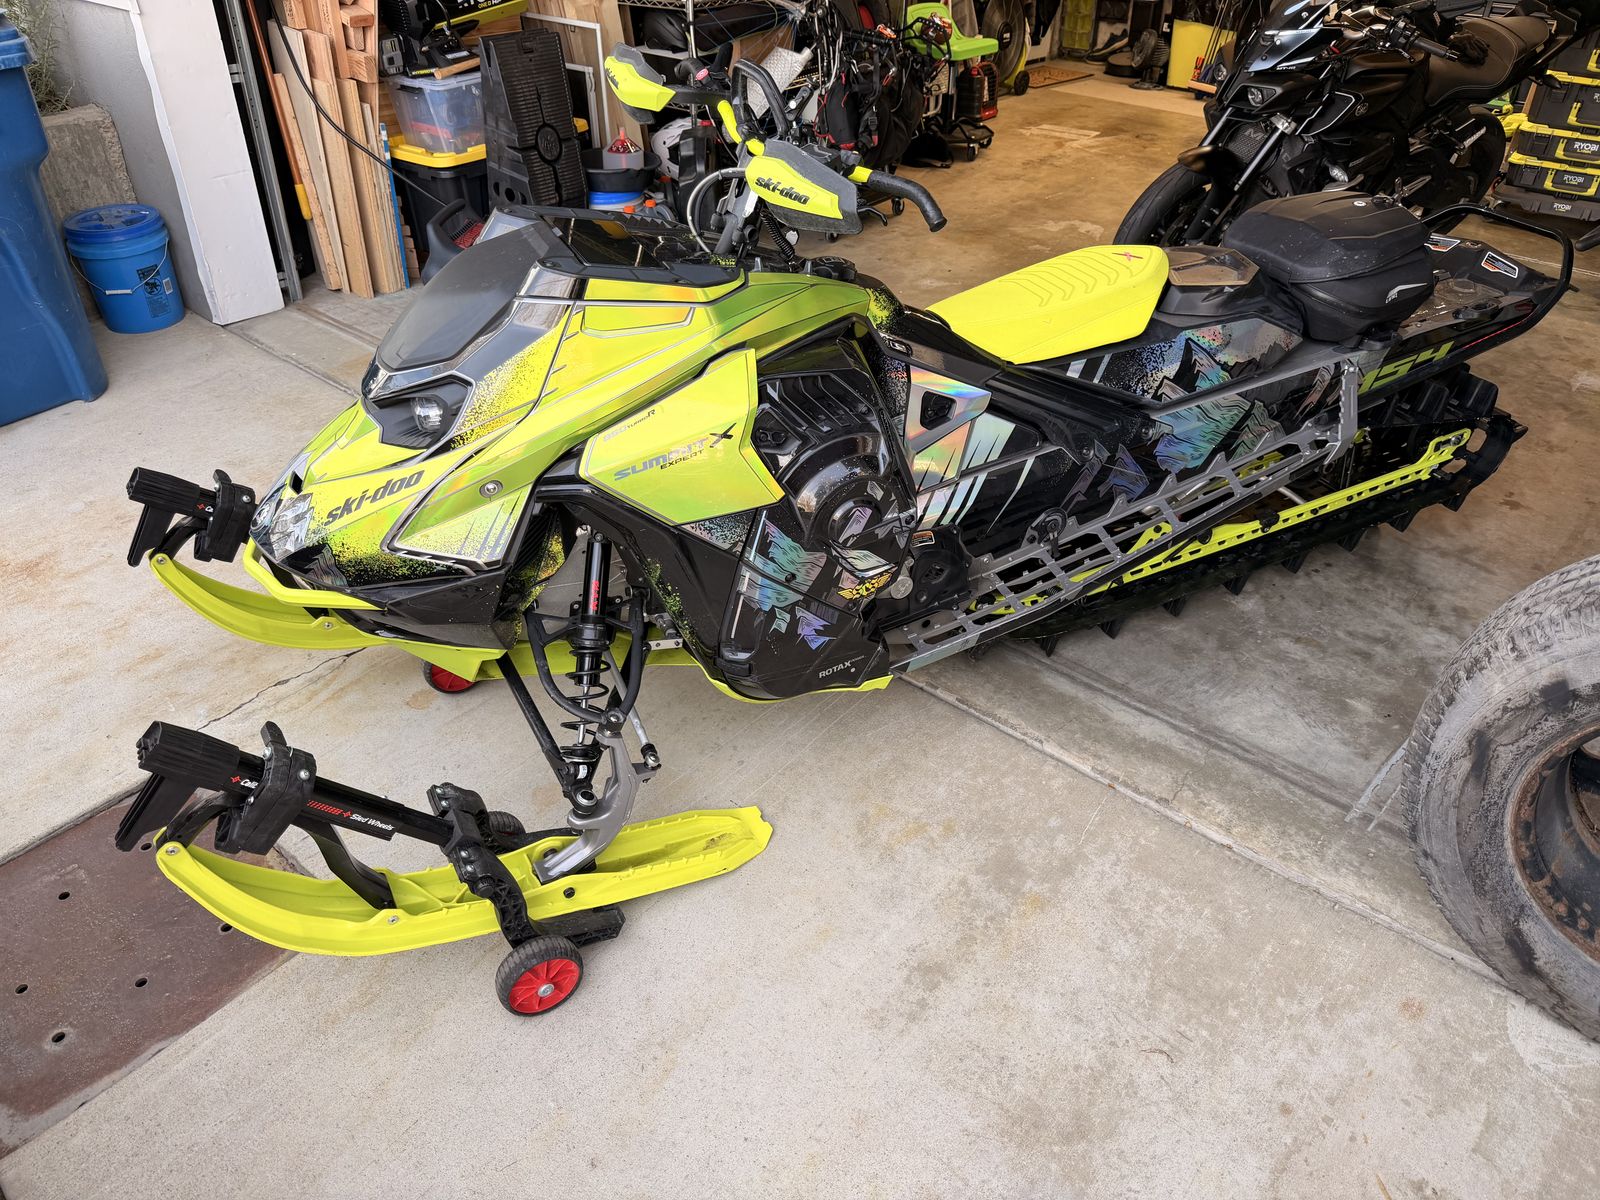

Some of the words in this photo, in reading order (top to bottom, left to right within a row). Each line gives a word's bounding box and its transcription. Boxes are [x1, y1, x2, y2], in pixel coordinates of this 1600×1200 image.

[1573, 141, 1600, 152] RYOBI
[1563, 174, 1585, 183] RYOBI
[755, 176, 810, 205] ski-doo
[1553, 202, 1572, 210] RYOBI
[660, 448, 704, 470] EXPERT
[323, 469, 425, 527] ski-doo
[818, 660, 851, 679] ROTAX
[350, 813, 370, 823] Sled
[367, 818, 395, 831] Wheels
